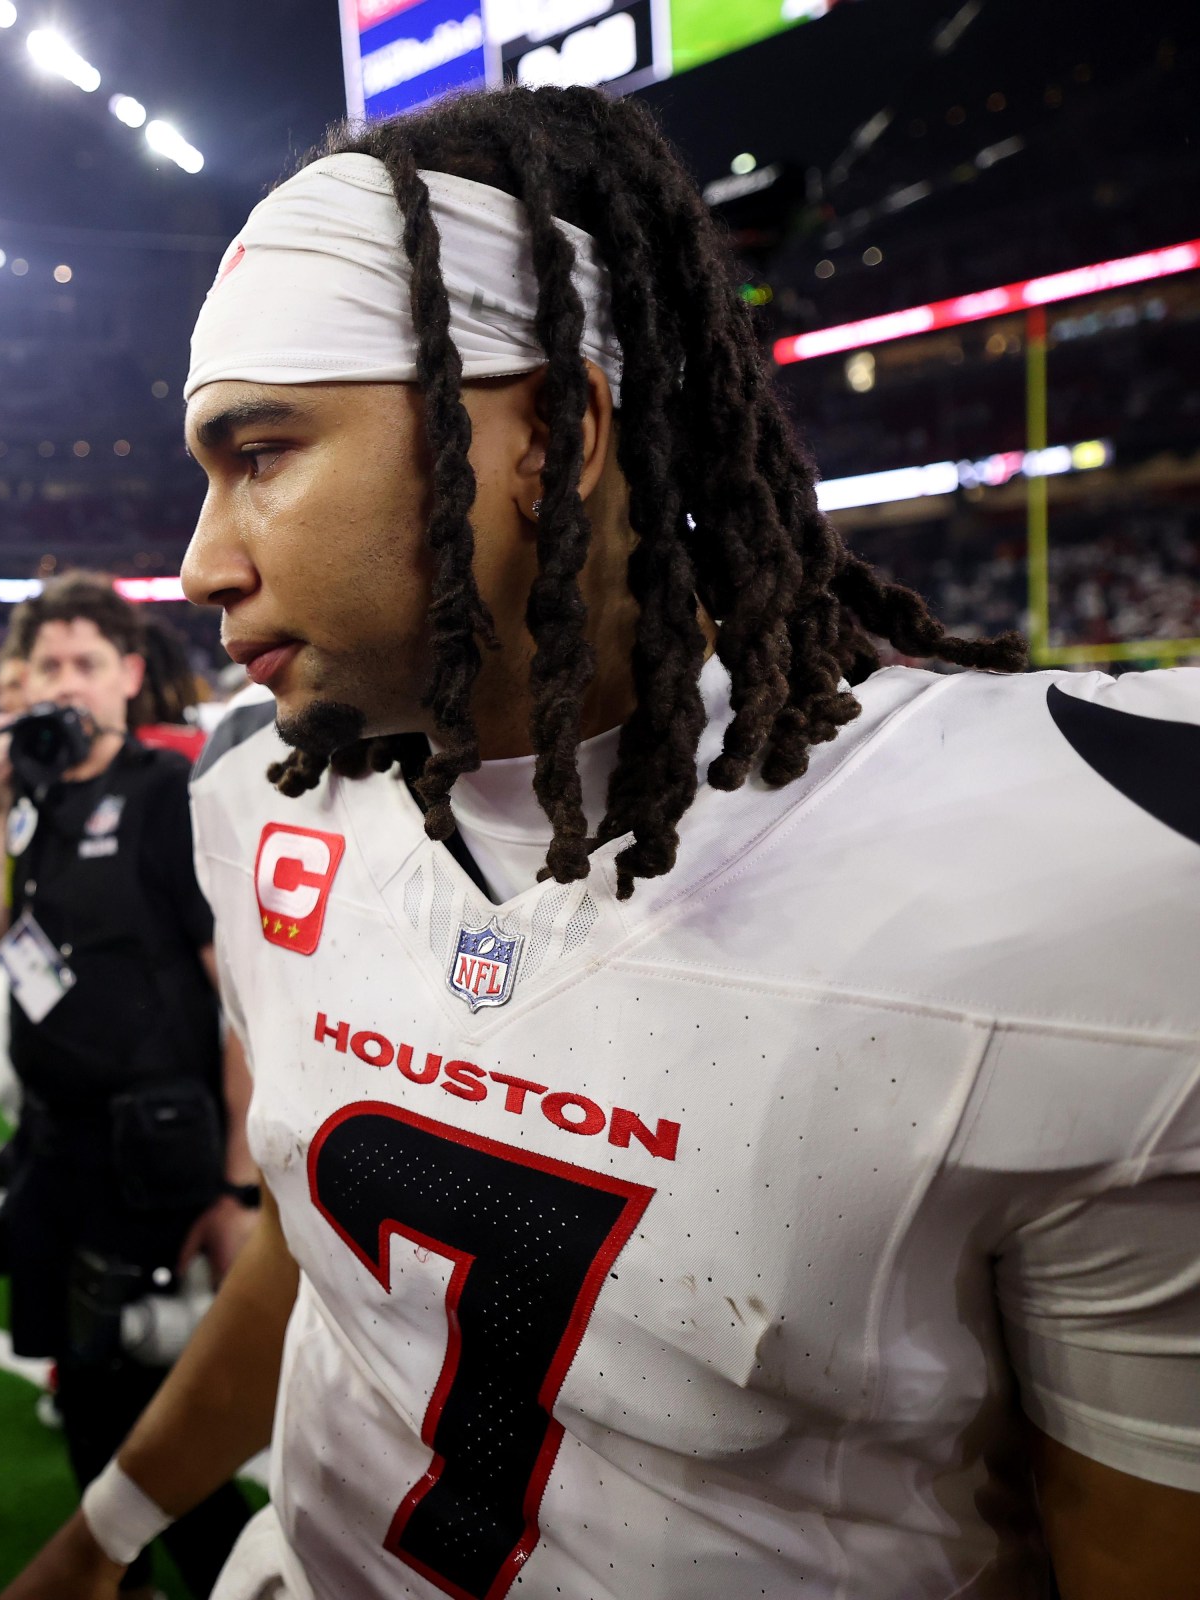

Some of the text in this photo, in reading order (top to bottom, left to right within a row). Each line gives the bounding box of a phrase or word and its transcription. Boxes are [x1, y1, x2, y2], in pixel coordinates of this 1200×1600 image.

[257, 831, 331, 920] C
[456, 955, 502, 996] NFL
[313, 1011, 682, 1162] HOUSTON
[307, 1099, 657, 1600] 7
